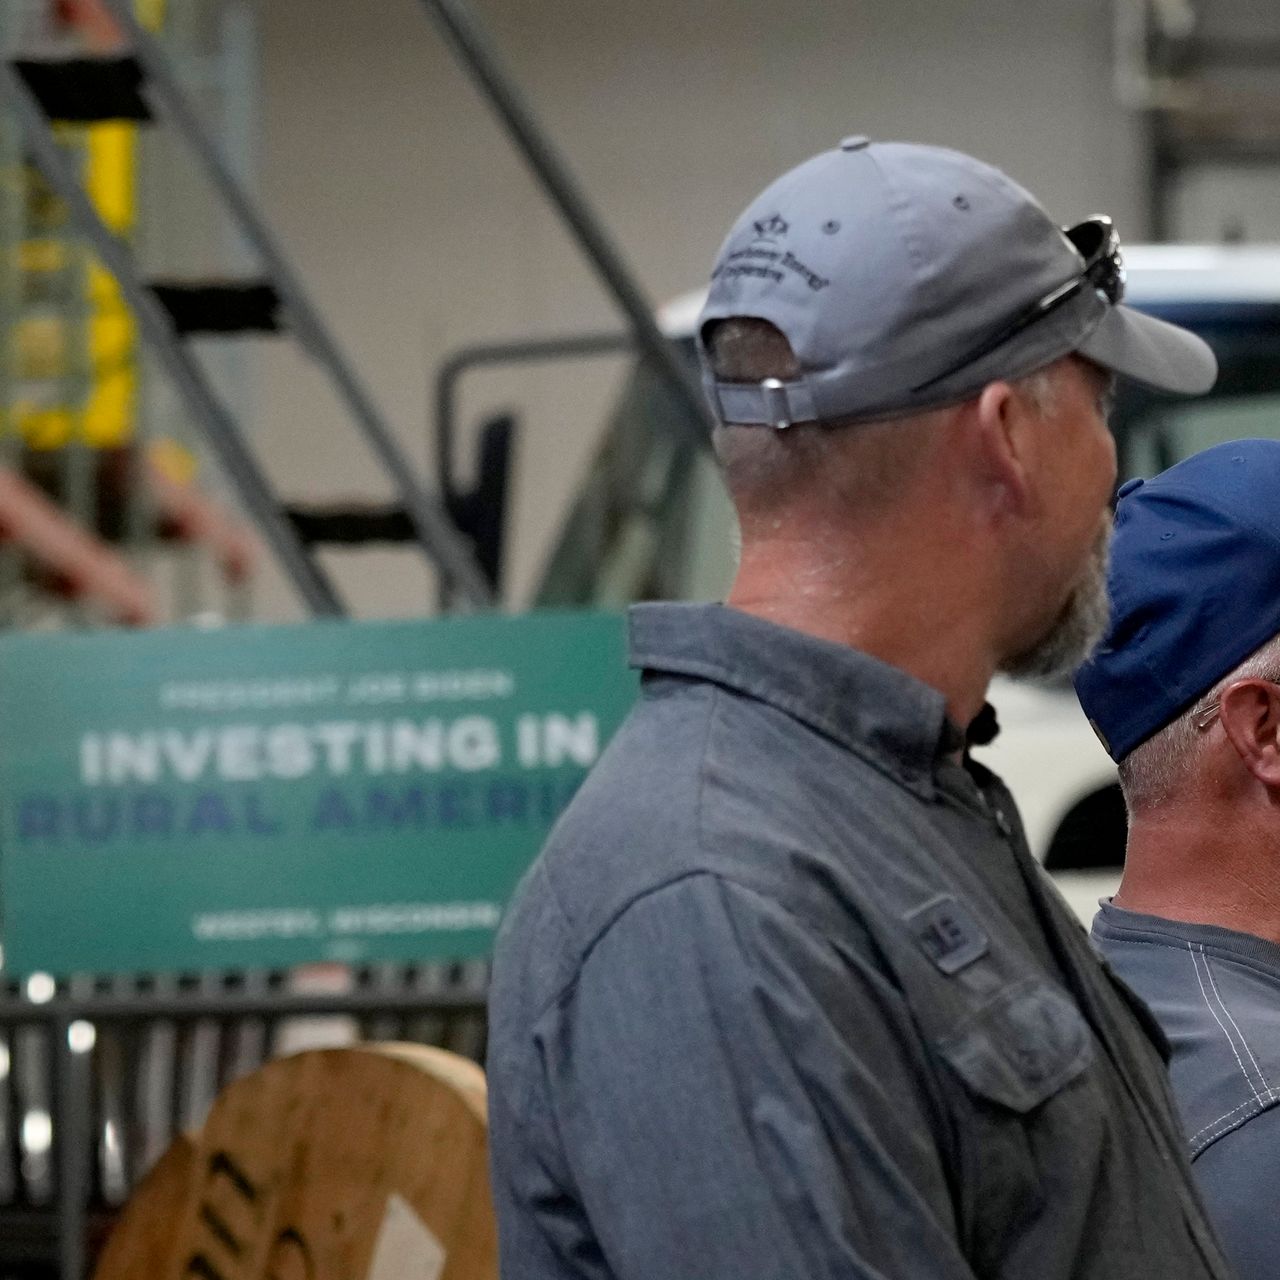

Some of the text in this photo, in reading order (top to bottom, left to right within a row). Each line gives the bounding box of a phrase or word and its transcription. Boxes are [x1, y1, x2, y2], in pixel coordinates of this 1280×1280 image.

[80, 711, 600, 787] INVESTING IN
[18, 776, 578, 843] RURAL AMERI
